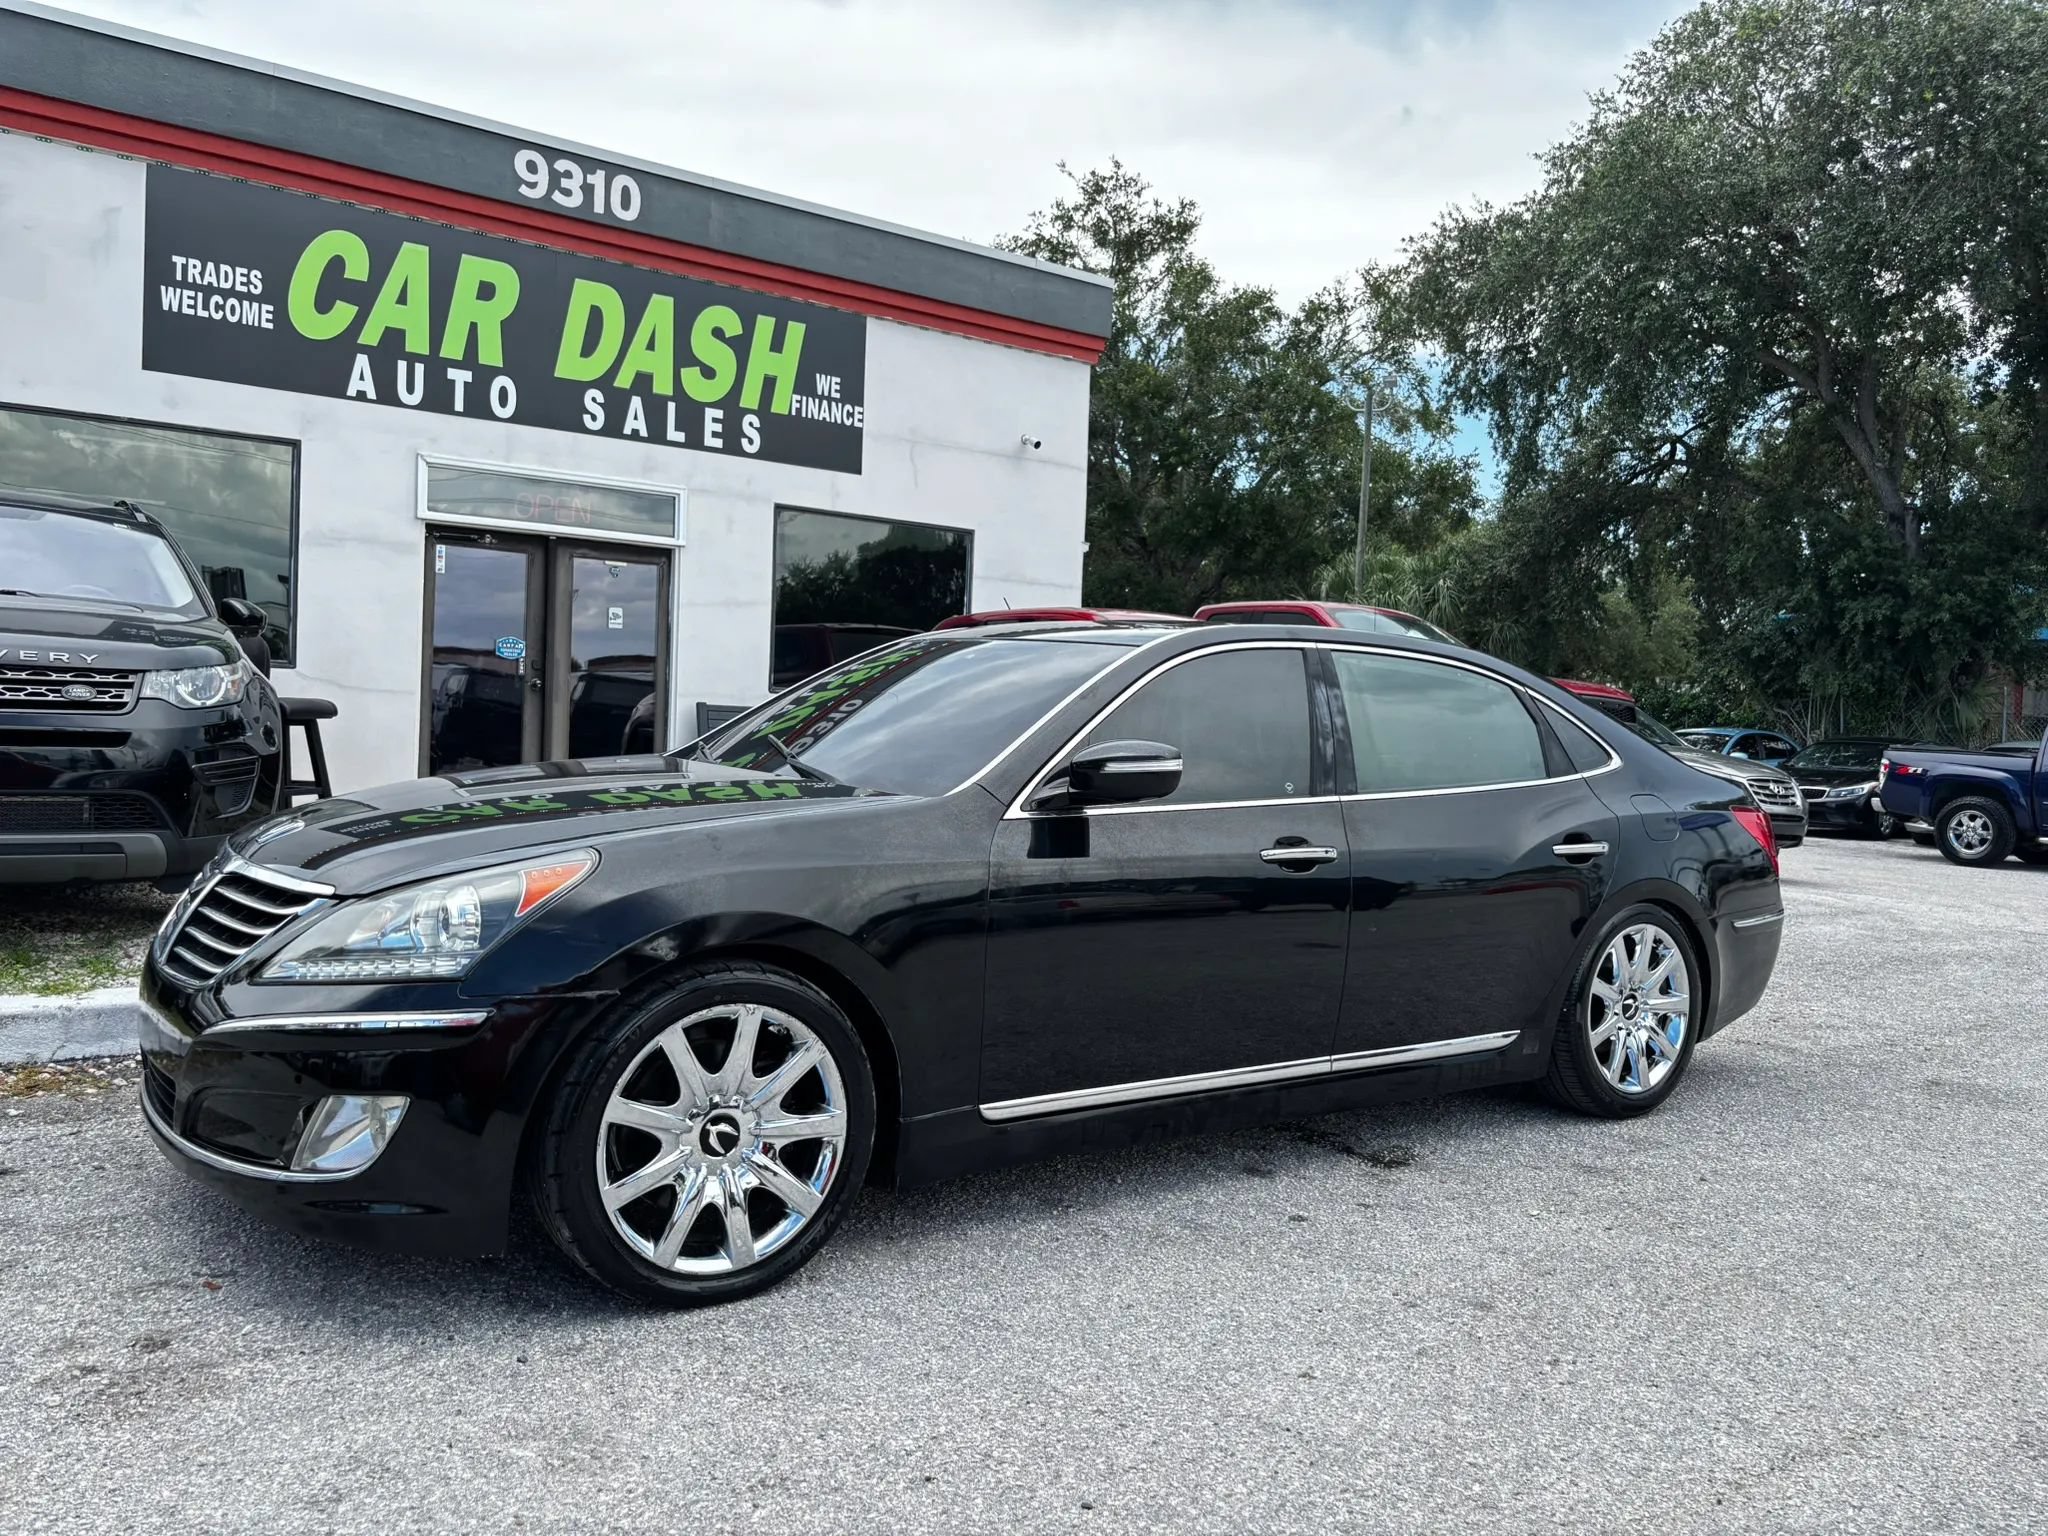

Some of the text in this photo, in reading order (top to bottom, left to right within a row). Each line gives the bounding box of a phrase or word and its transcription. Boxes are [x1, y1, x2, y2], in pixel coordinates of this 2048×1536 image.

[514, 149, 642, 221] 9310
[172, 255, 263, 295] TRADES
[160, 285, 274, 330] WELCOME
[288, 230, 807, 415] CAR DASH
[346, 353, 761, 454] AUTO SALES
[816, 373, 841, 399] WE
[791, 394, 864, 428] FINANCE
[514, 492, 592, 524] OPEN
